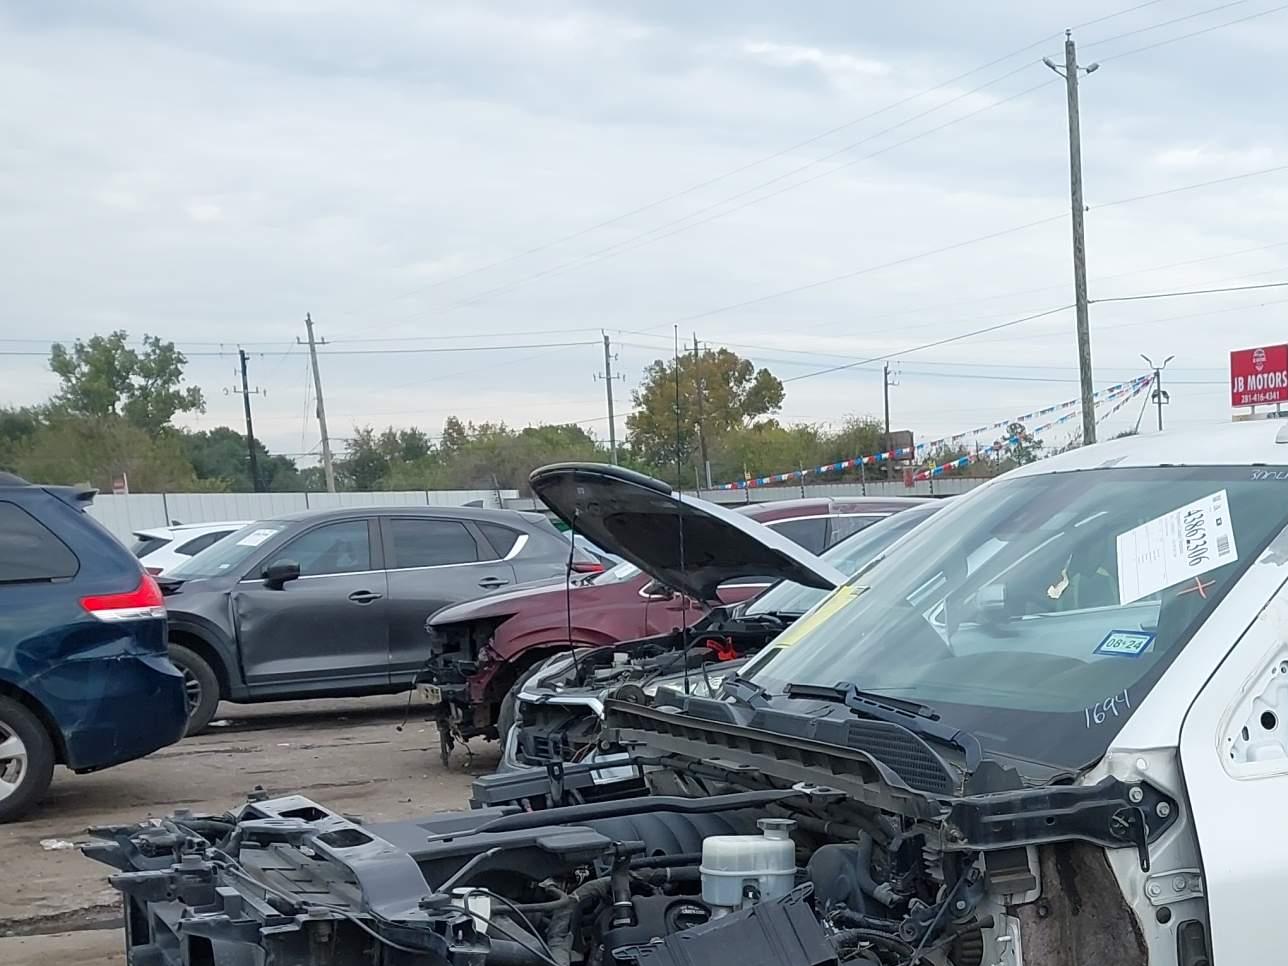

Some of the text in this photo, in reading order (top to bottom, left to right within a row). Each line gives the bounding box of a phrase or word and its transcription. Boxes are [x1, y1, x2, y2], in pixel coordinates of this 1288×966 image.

[1233, 370, 1288, 393] JB MOTORS
[1184, 509, 1210, 567] 43862306
[1106, 638, 1120, 648] 08
[1085, 688, 1131, 729] 1694
